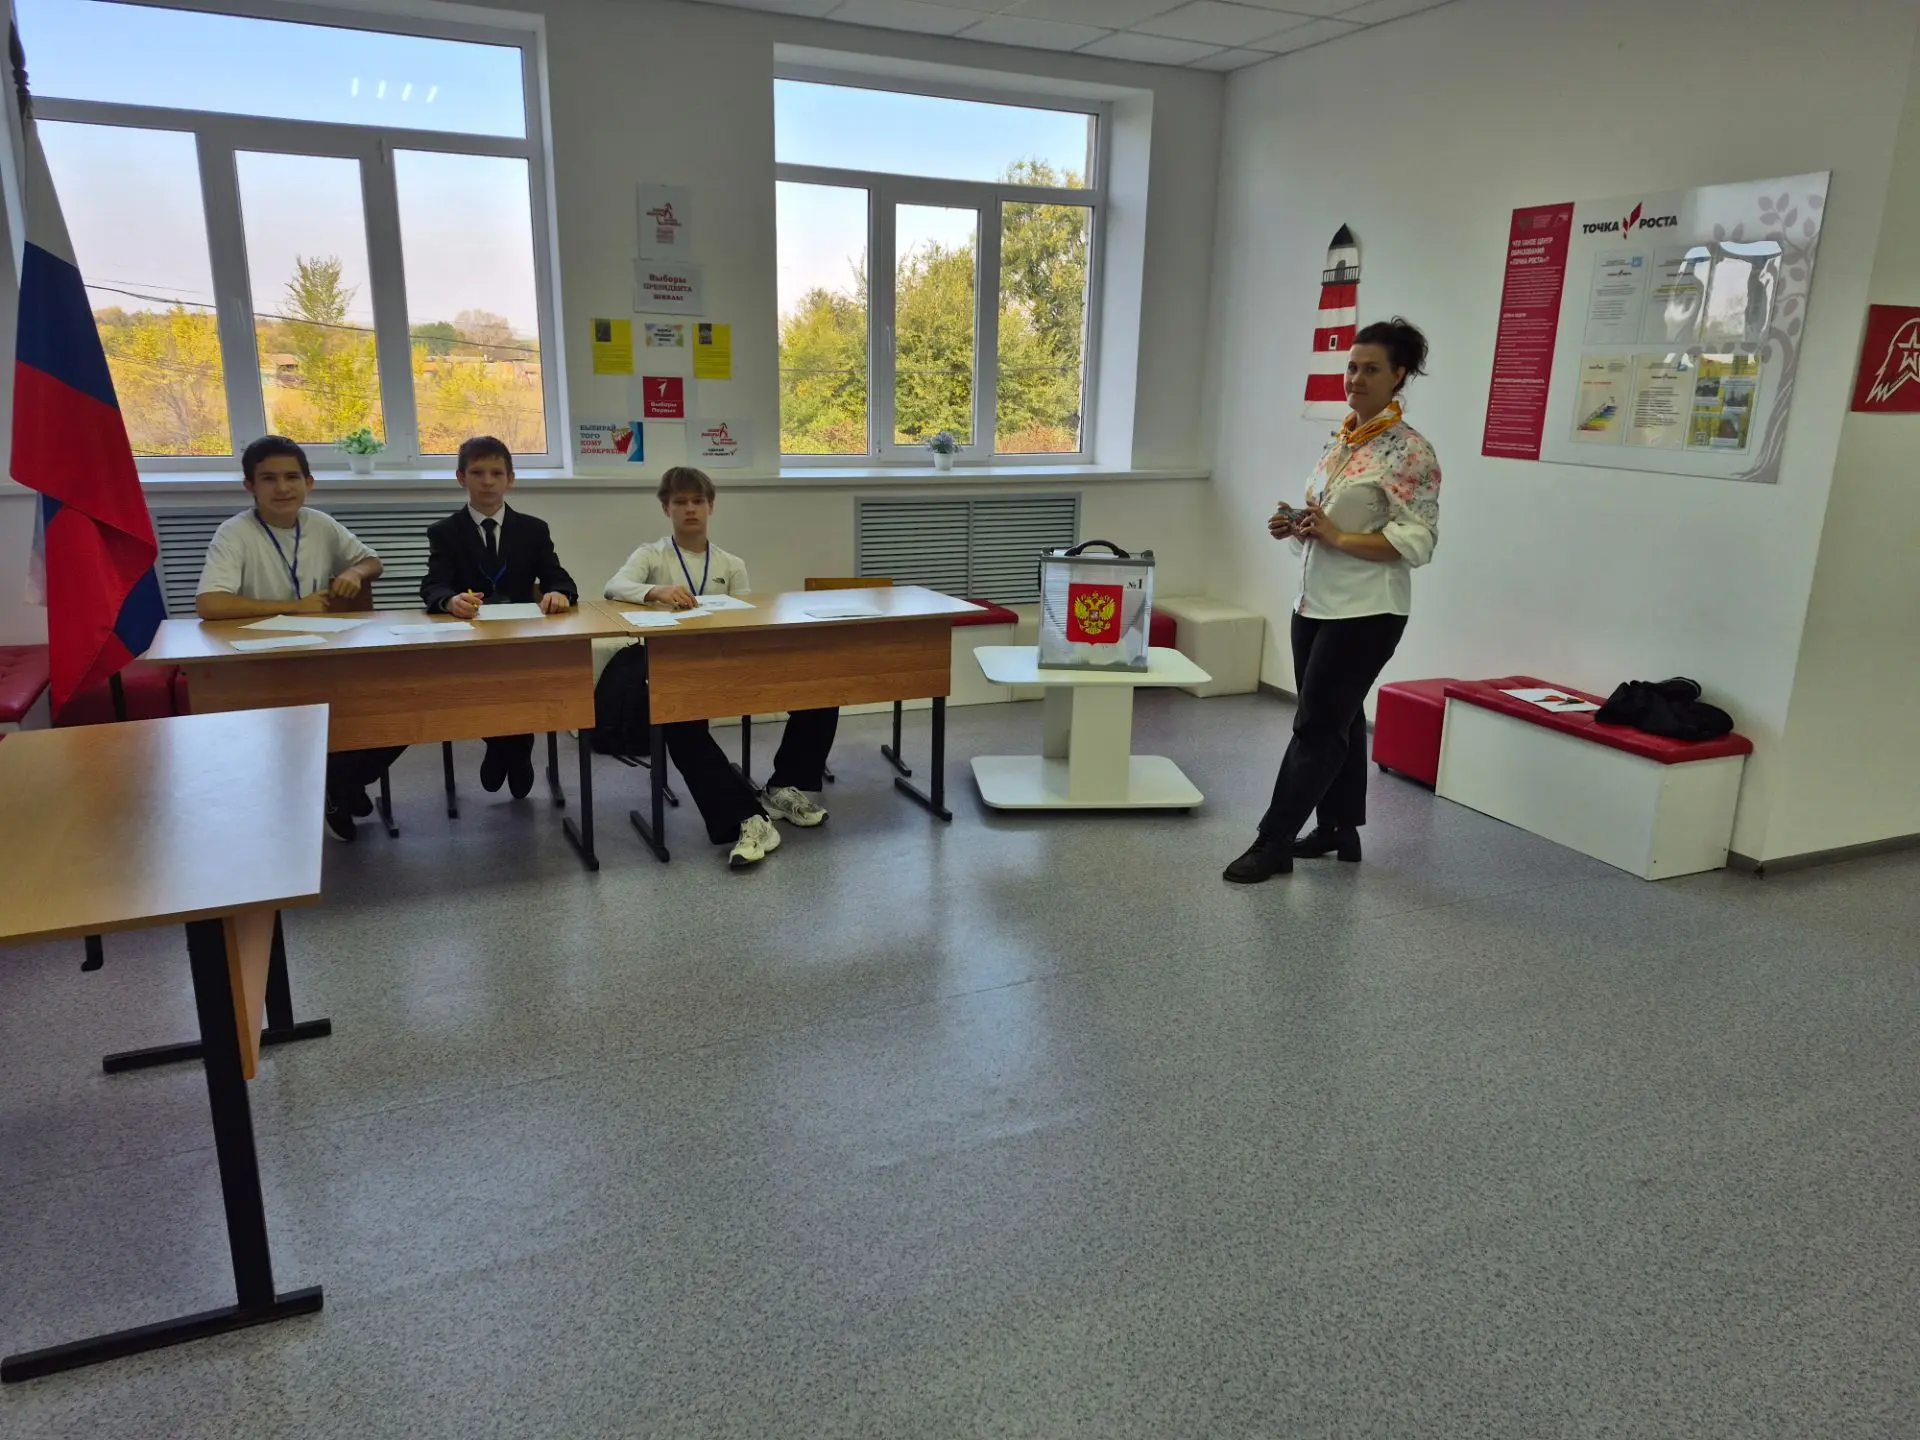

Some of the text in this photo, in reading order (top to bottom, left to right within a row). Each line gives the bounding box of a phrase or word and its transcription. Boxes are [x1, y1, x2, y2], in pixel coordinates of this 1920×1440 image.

[1583, 215, 1677, 234] ТОЧКА РОСТА
[649, 273, 686, 283] Выборы
